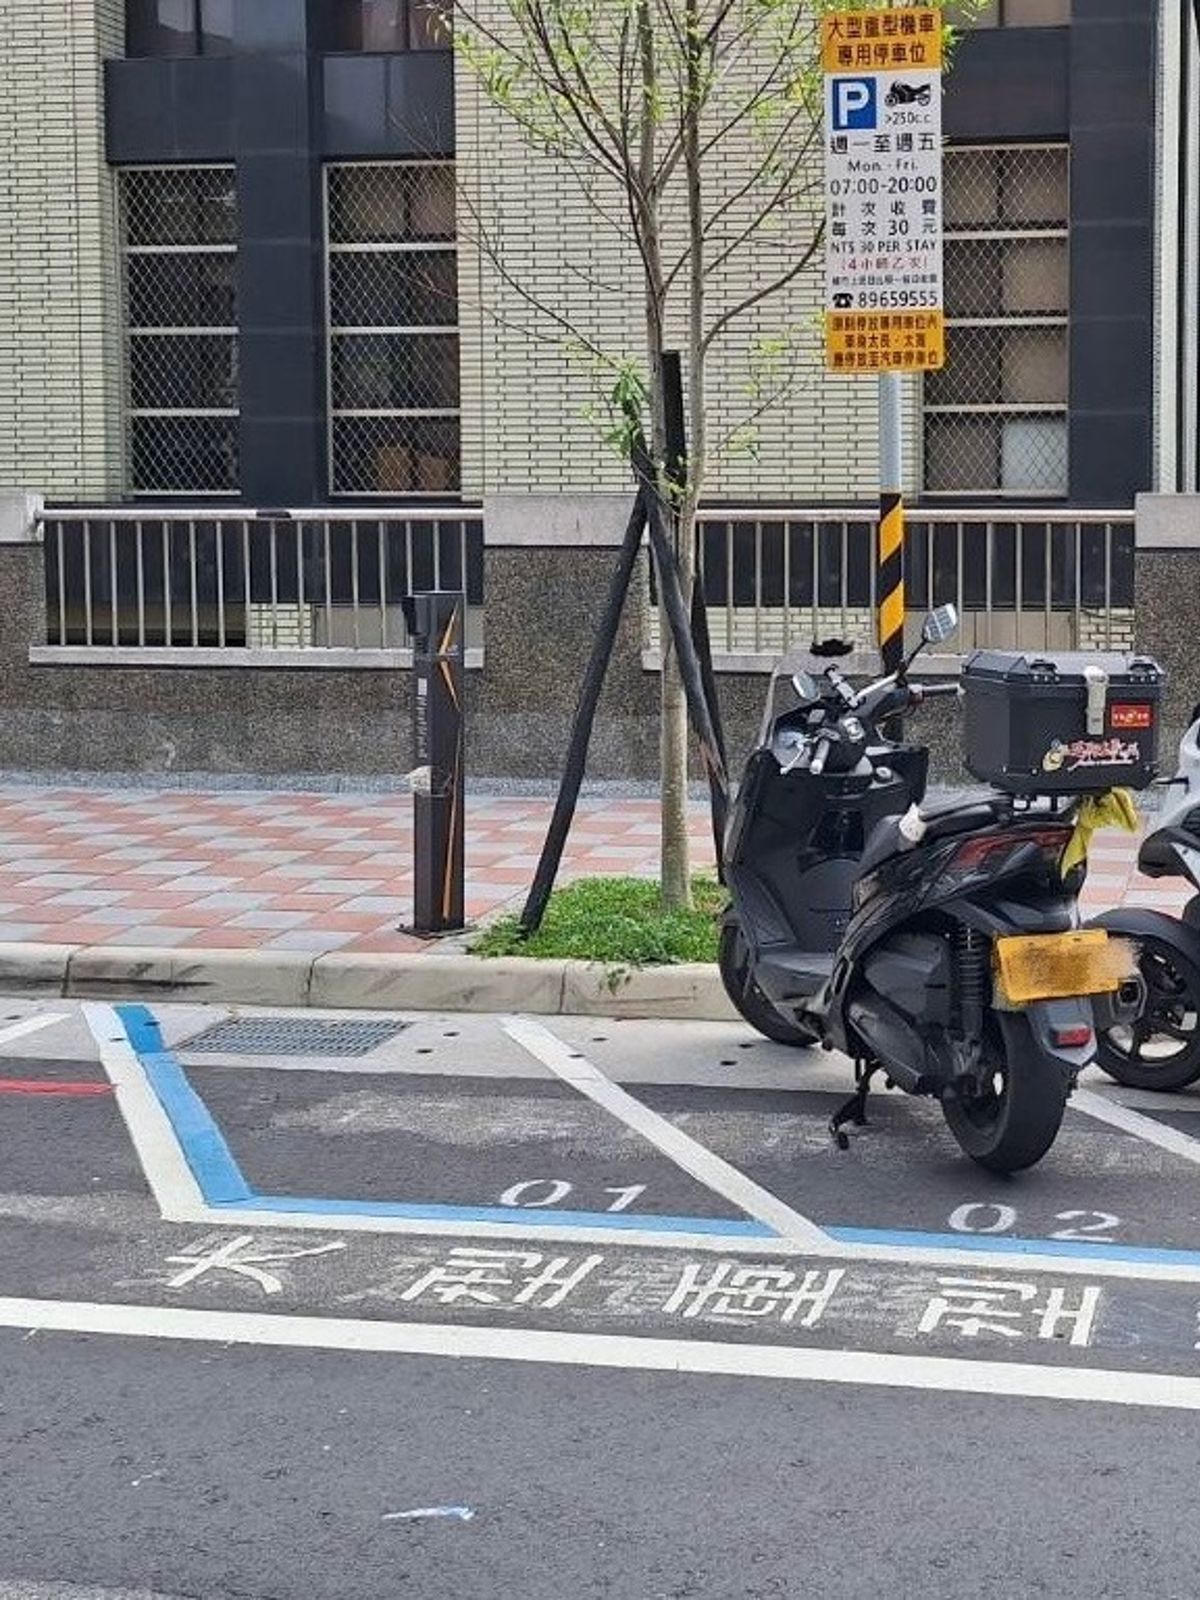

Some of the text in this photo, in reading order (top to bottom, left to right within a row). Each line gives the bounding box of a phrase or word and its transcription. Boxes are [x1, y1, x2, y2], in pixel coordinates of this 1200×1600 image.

[828, 14, 934, 40] 大型重型機車
[838, 41, 925, 65] 專用停車位
[838, 82, 870, 127] P
[830, 132, 935, 154] 週一至週五
[830, 176, 937, 196] 07:00-20:00
[878, 240, 900, 253] PER
[907, 239, 936, 251] STAY
[858, 291, 938, 308] 89659555
[499, 1179, 647, 1212] 01
[948, 1203, 1121, 1242] 02
